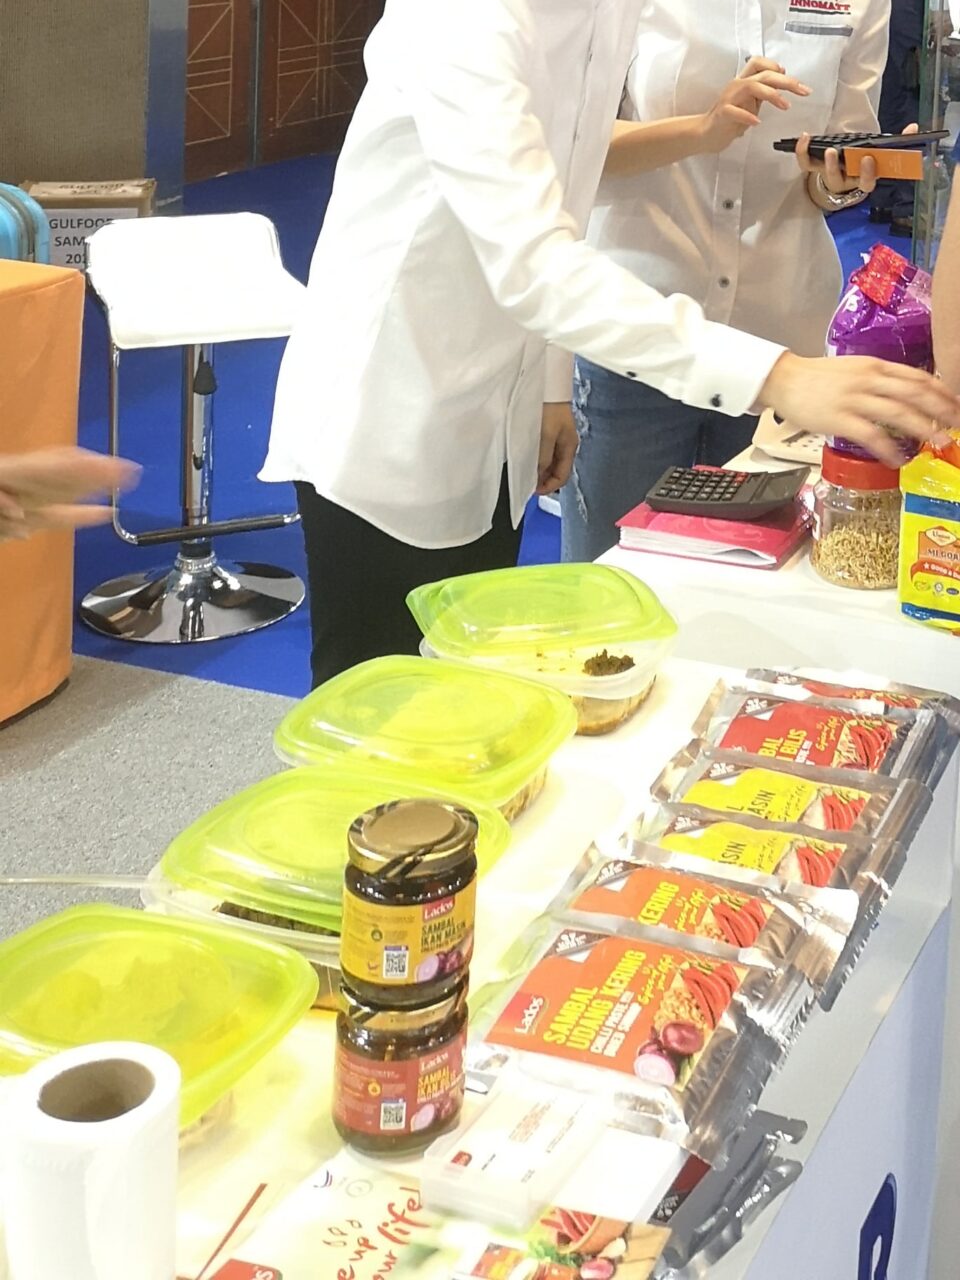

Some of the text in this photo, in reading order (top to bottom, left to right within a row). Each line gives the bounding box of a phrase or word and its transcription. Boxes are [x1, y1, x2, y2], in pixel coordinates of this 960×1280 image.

[758, 736, 784, 757] BAL
[747, 789, 777, 817] ASIN
[718, 840, 748, 865] SIN
[421, 917, 455, 936] SAMBAL
[420, 931, 442, 948] IKAN
[565, 998, 614, 1051] UDANG
[600, 949, 647, 998] KERING
[542, 986, 599, 1045] SAMBAL
